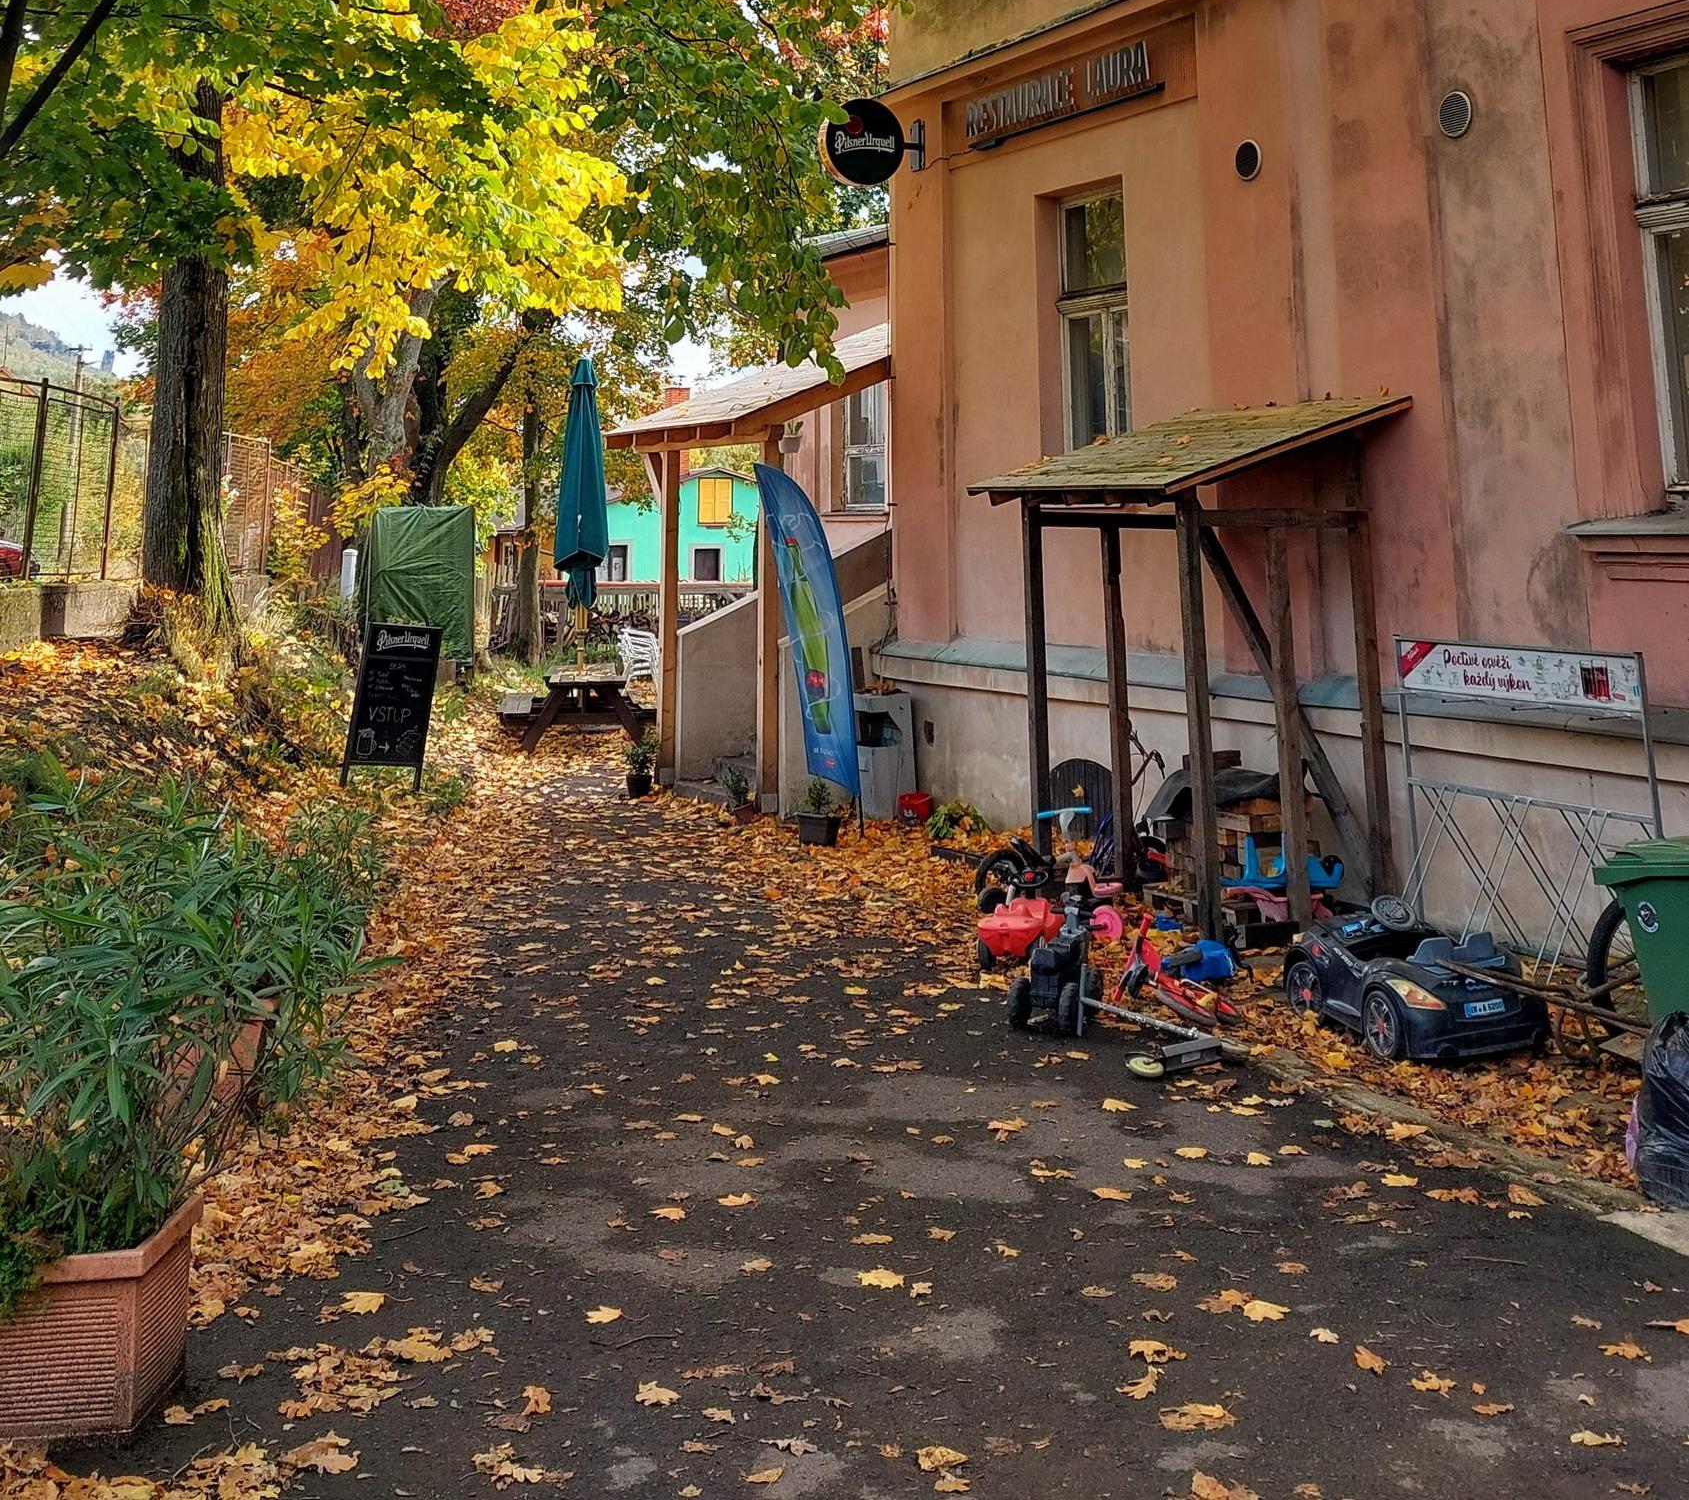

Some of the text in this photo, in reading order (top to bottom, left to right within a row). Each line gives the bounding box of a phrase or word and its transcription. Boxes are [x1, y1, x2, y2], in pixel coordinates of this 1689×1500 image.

[965, 40, 1151, 138] RESTAURACE LAURA
[834, 130, 895, 155] Pilsner Urquell
[376, 629, 431, 652] Pilsner Urquell
[1463, 669, 1532, 692] každý výkon
[368, 706, 412, 725] VSTUP
